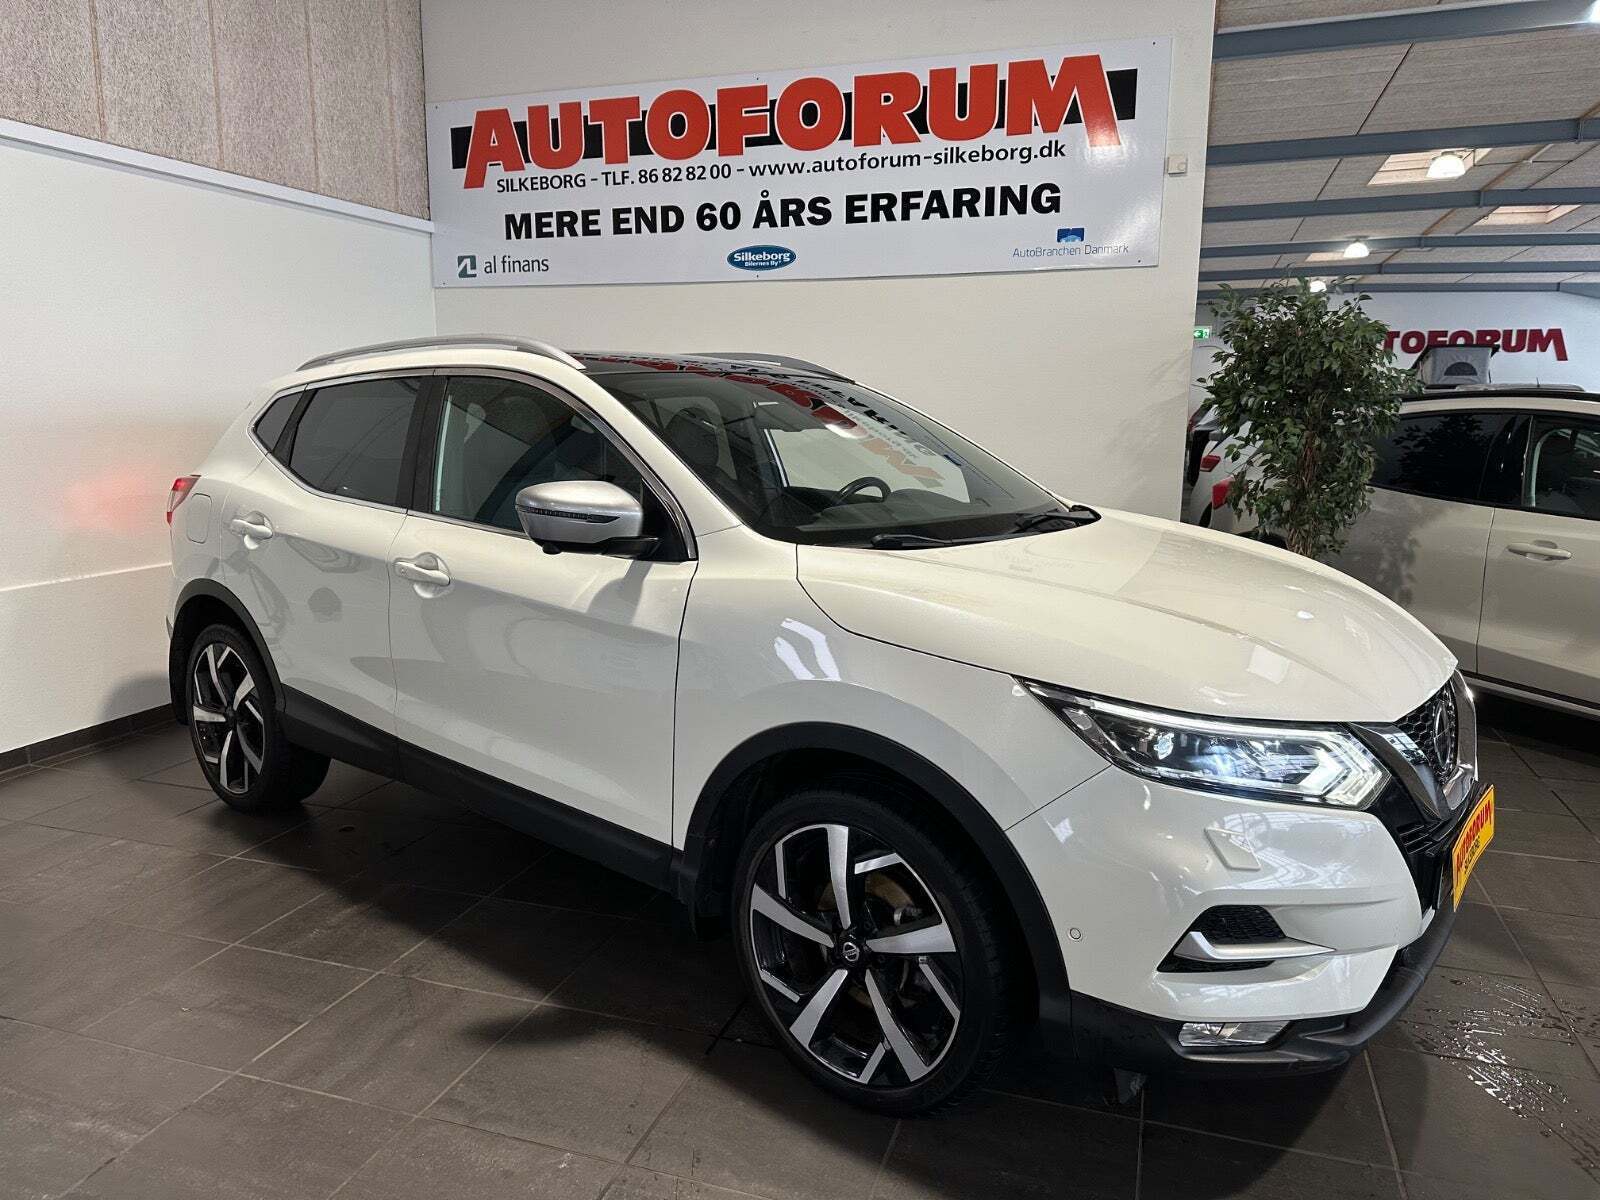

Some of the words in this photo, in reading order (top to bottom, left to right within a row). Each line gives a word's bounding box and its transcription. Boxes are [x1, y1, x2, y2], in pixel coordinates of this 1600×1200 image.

[463, 53, 1121, 189] AUTOFORUM
[496, 173, 587, 193] SILKEBORG
[602, 170, 635, 187] TLF.
[749, 139, 1066, 177] www.autoforum-silkeborg.dk
[504, 209, 602, 241] MERE
[612, 202, 685, 236] END
[696, 201, 741, 232] 60
[752, 189, 832, 229] ÅRS
[845, 182, 1061, 225] ERFARING
[483, 255, 497, 274] al
[501, 254, 550, 274] finans
[733, 251, 791, 262] Silkeborg
[1012, 245, 1081, 258] AutoBranchen
[1084, 243, 1129, 256] Danmark
